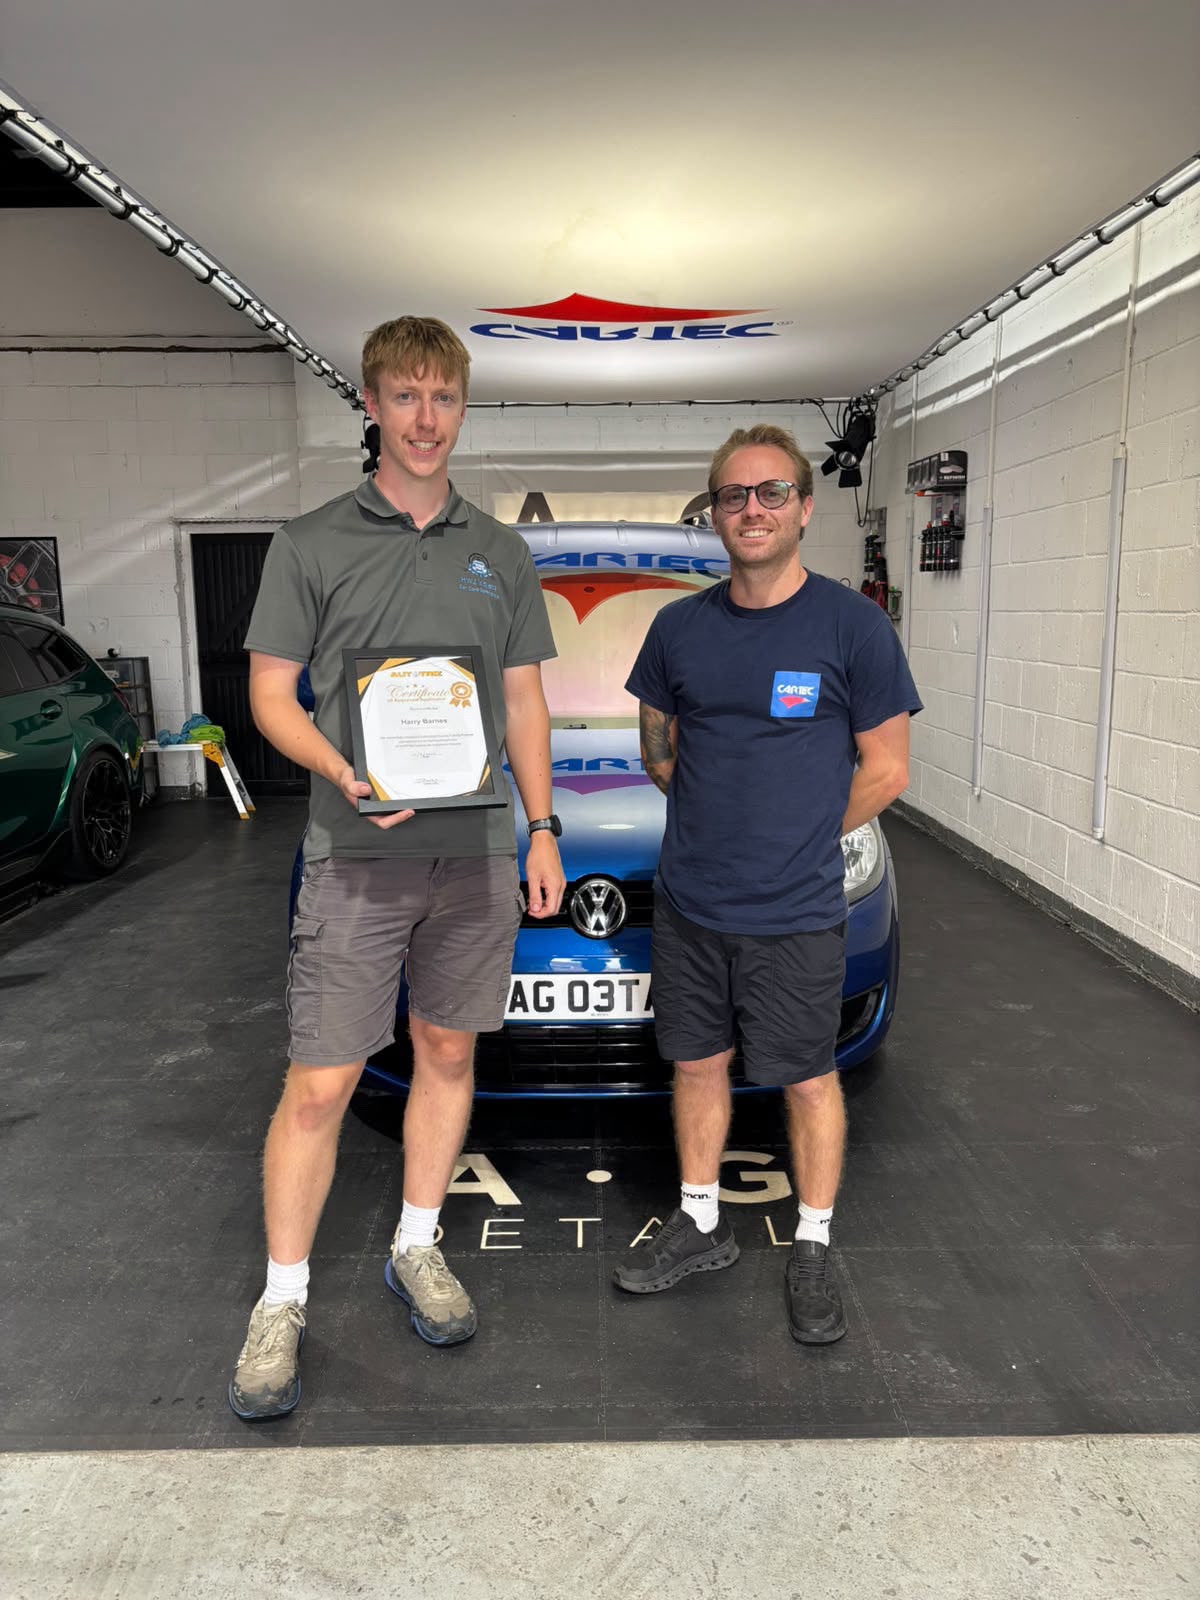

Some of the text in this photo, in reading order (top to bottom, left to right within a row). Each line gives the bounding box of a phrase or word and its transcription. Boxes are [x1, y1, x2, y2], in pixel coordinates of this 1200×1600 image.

[532, 552, 731, 579] ARTEC
[386, 684, 449, 700] Certificate
[777, 684, 815, 696] CARTEC
[508, 980, 555, 1013] AG
